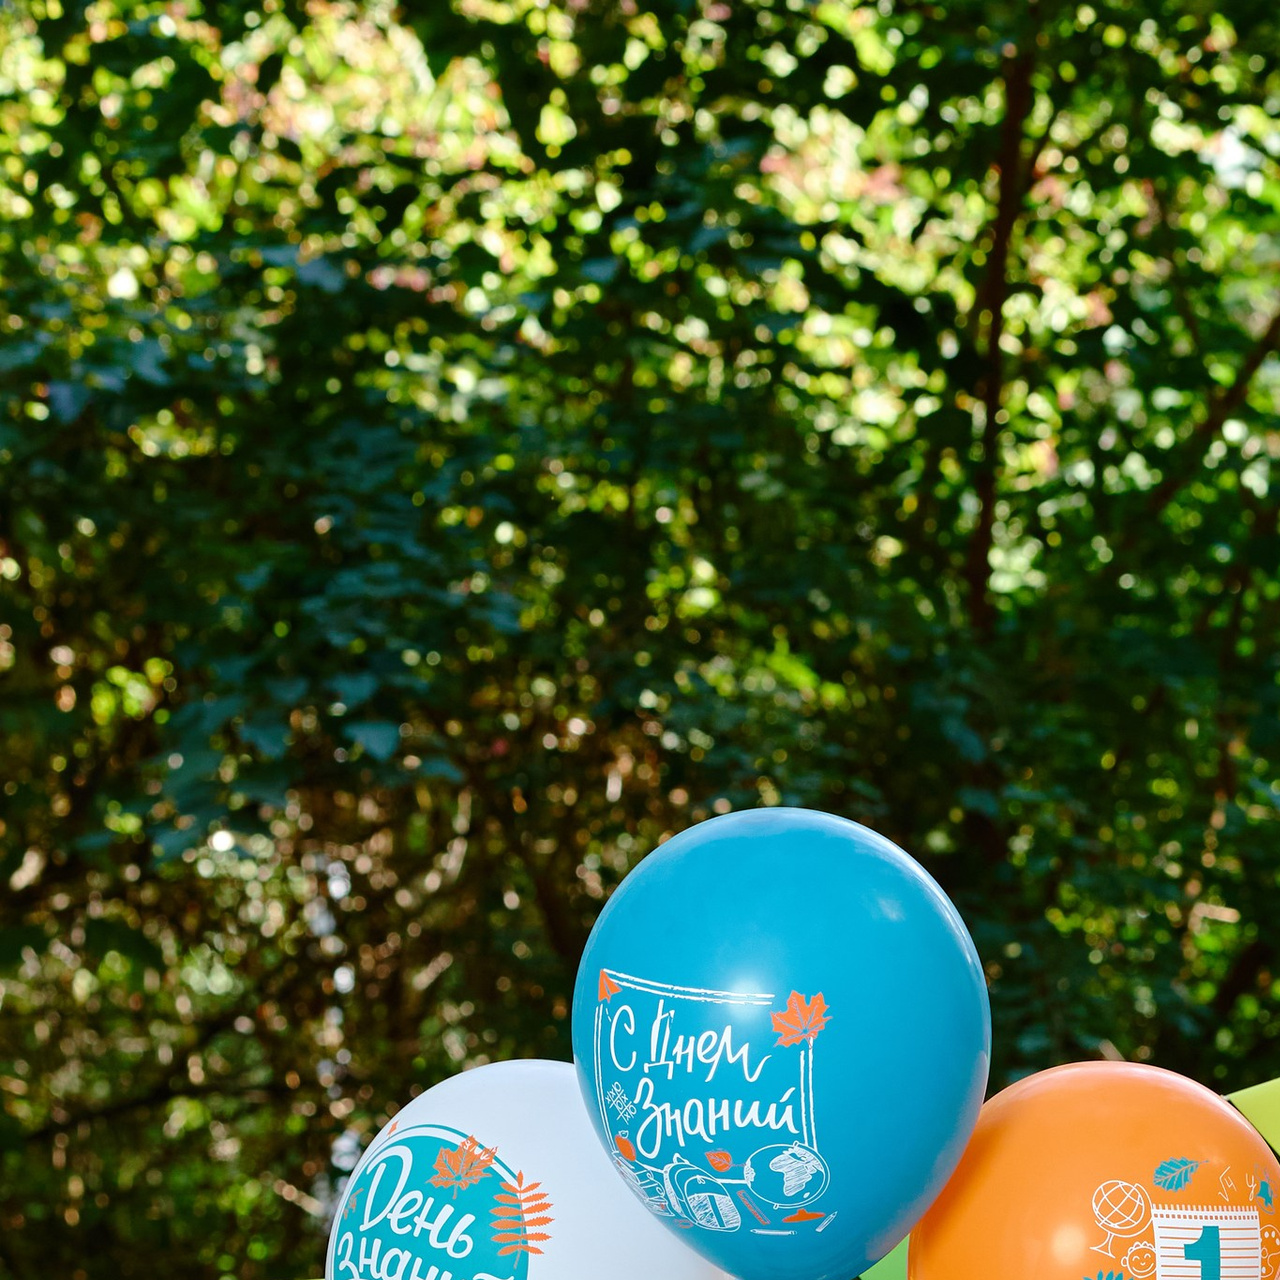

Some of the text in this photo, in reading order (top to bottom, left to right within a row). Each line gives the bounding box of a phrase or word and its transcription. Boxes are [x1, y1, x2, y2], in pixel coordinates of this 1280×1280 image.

[610, 999, 772, 1083] С Днем
[633, 1077, 800, 1159] Знаний
[359, 1145, 476, 1259] День
